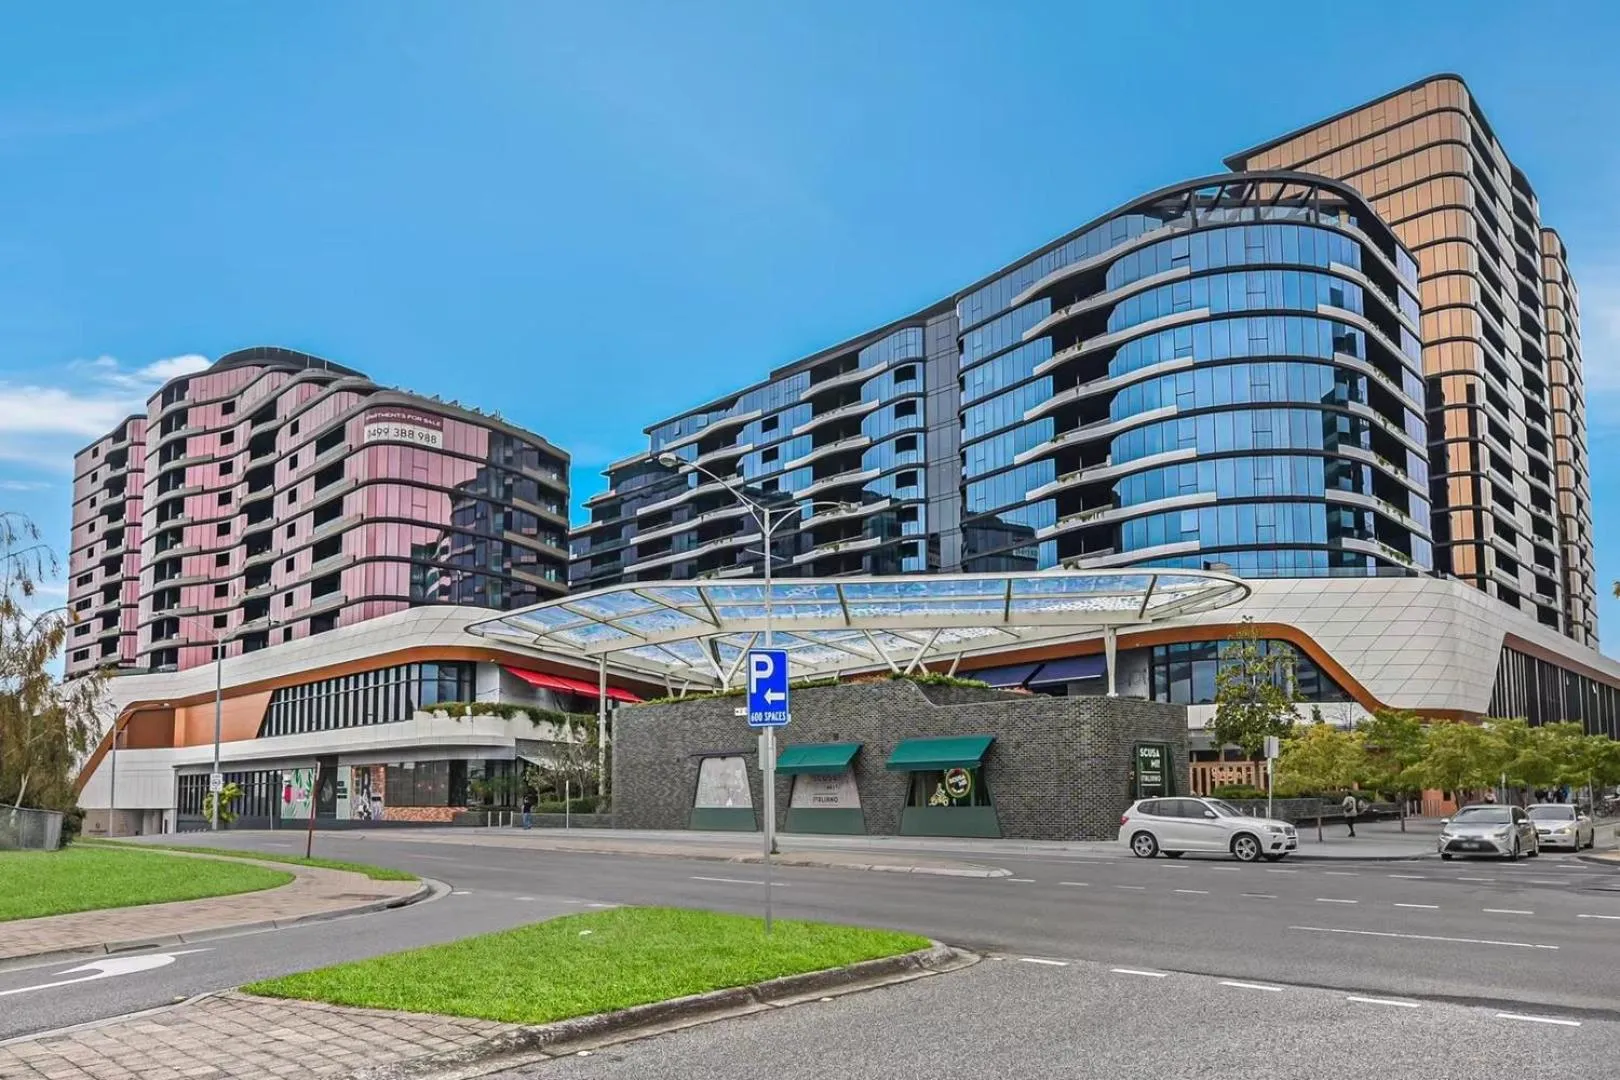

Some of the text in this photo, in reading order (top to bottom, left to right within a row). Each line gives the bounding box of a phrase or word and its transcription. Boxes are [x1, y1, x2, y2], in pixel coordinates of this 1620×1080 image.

[407, 414, 422, 422] FOR
[393, 428, 414, 439] 388
[418, 431, 437, 444] 988
[750, 653, 774, 694] P
[751, 711, 786, 722] 600 SPACES
[1140, 747, 1160, 758] SCUSA
